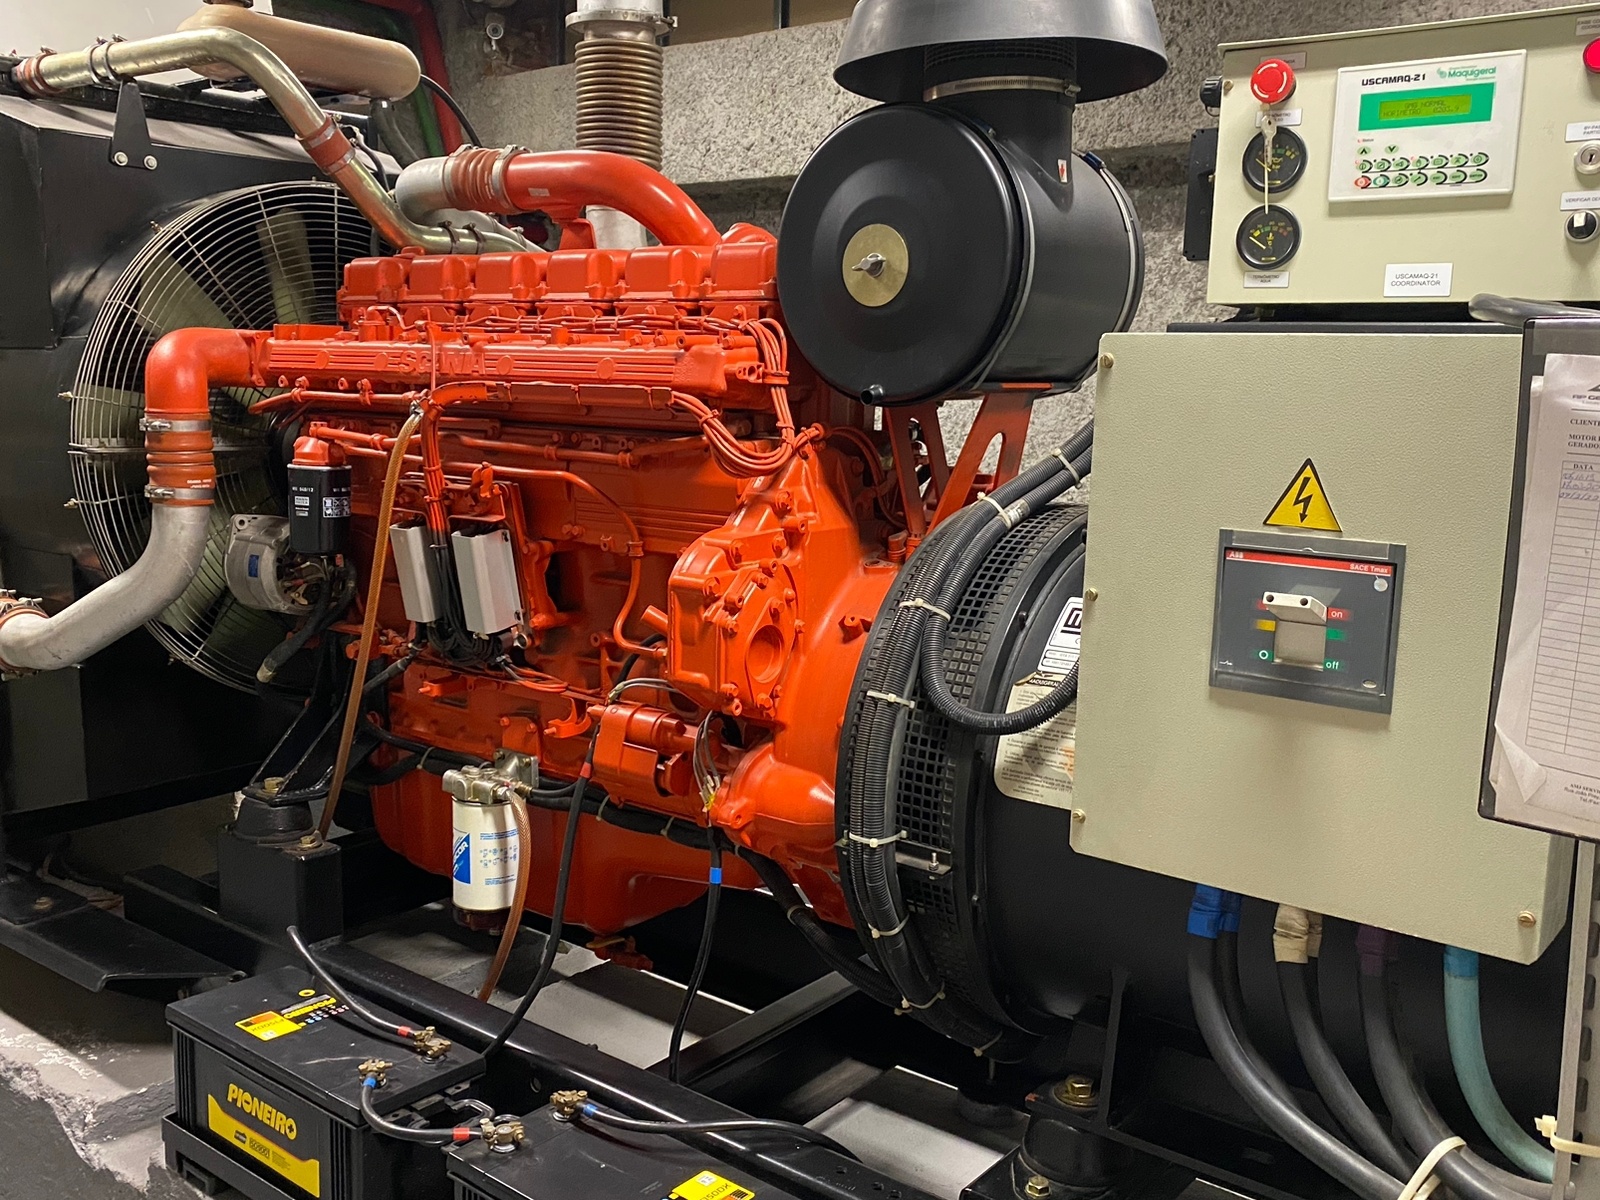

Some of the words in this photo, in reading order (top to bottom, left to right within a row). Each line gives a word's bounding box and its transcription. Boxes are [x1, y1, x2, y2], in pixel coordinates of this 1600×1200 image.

[1448, 67, 1497, 78] Maquigeral
[1361, 73, 1426, 86] USCAMAQ-21
[1569, 433, 1597, 442] MOTOR
[1567, 441, 1600, 450] GERADO
[1573, 463, 1594, 471] DATA
[1349, 563, 1369, 572] SACE
[1370, 565, 1388, 574] Tmax
[1331, 610, 1343, 618] on
[1325, 659, 1340, 670] off
[227, 1083, 297, 1140] PIONEIRO
